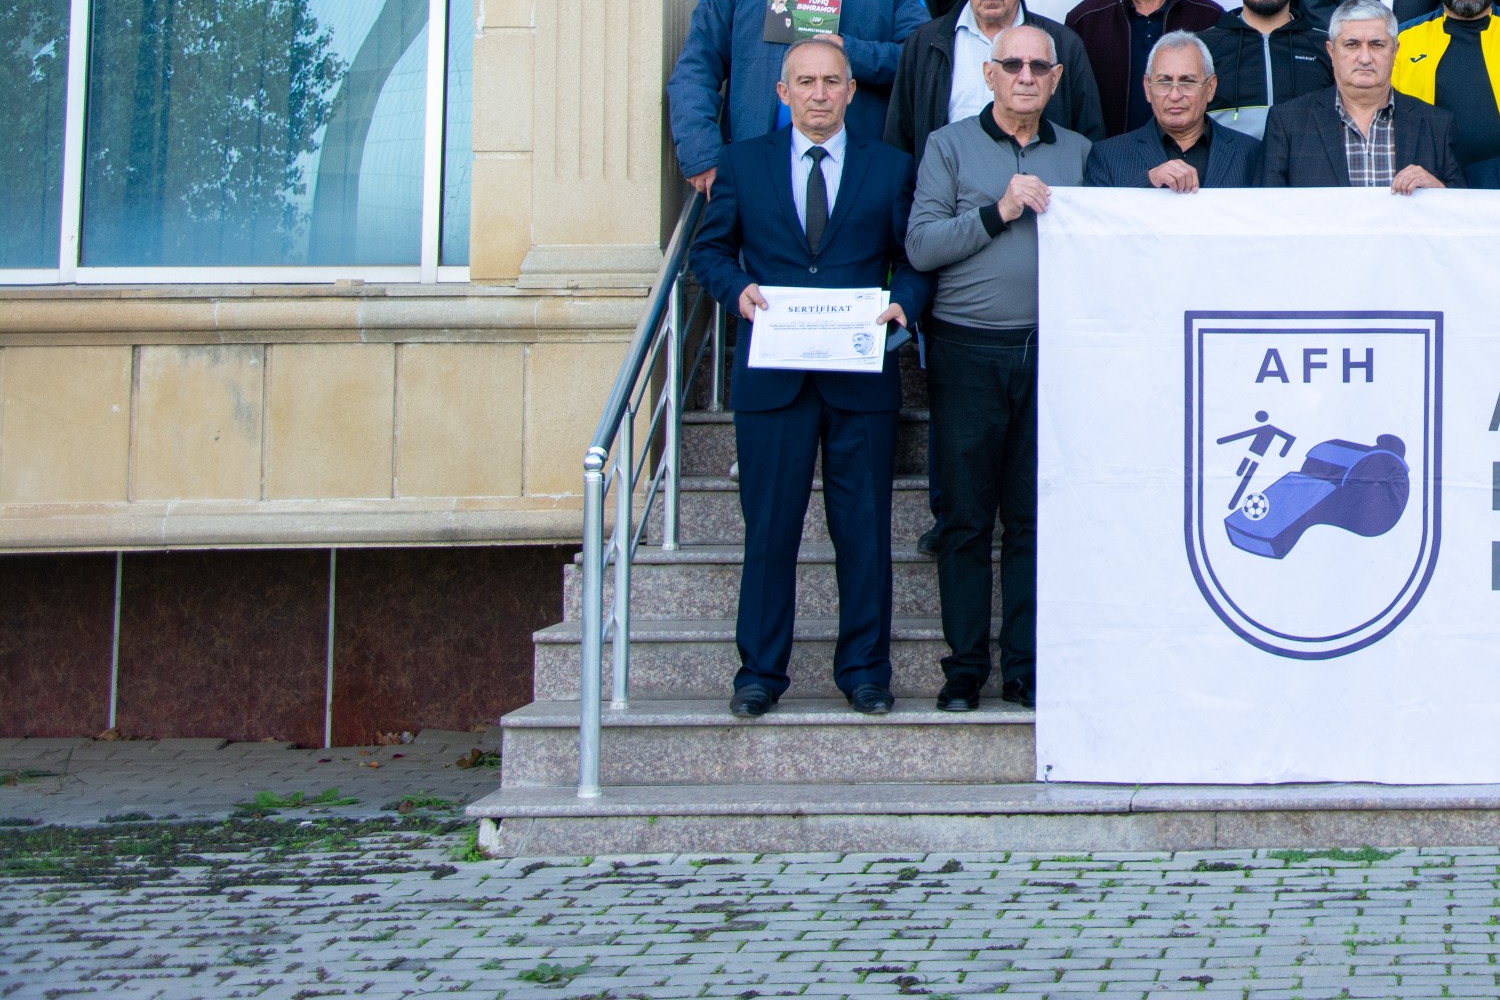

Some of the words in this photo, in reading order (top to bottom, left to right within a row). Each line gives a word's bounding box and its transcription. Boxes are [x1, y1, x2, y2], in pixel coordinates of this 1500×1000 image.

[797, 3, 837, 13] BƏHRAMOV
[787, 304, 853, 313] SERTİFİKAT
[1255, 348, 1374, 384] AFH
